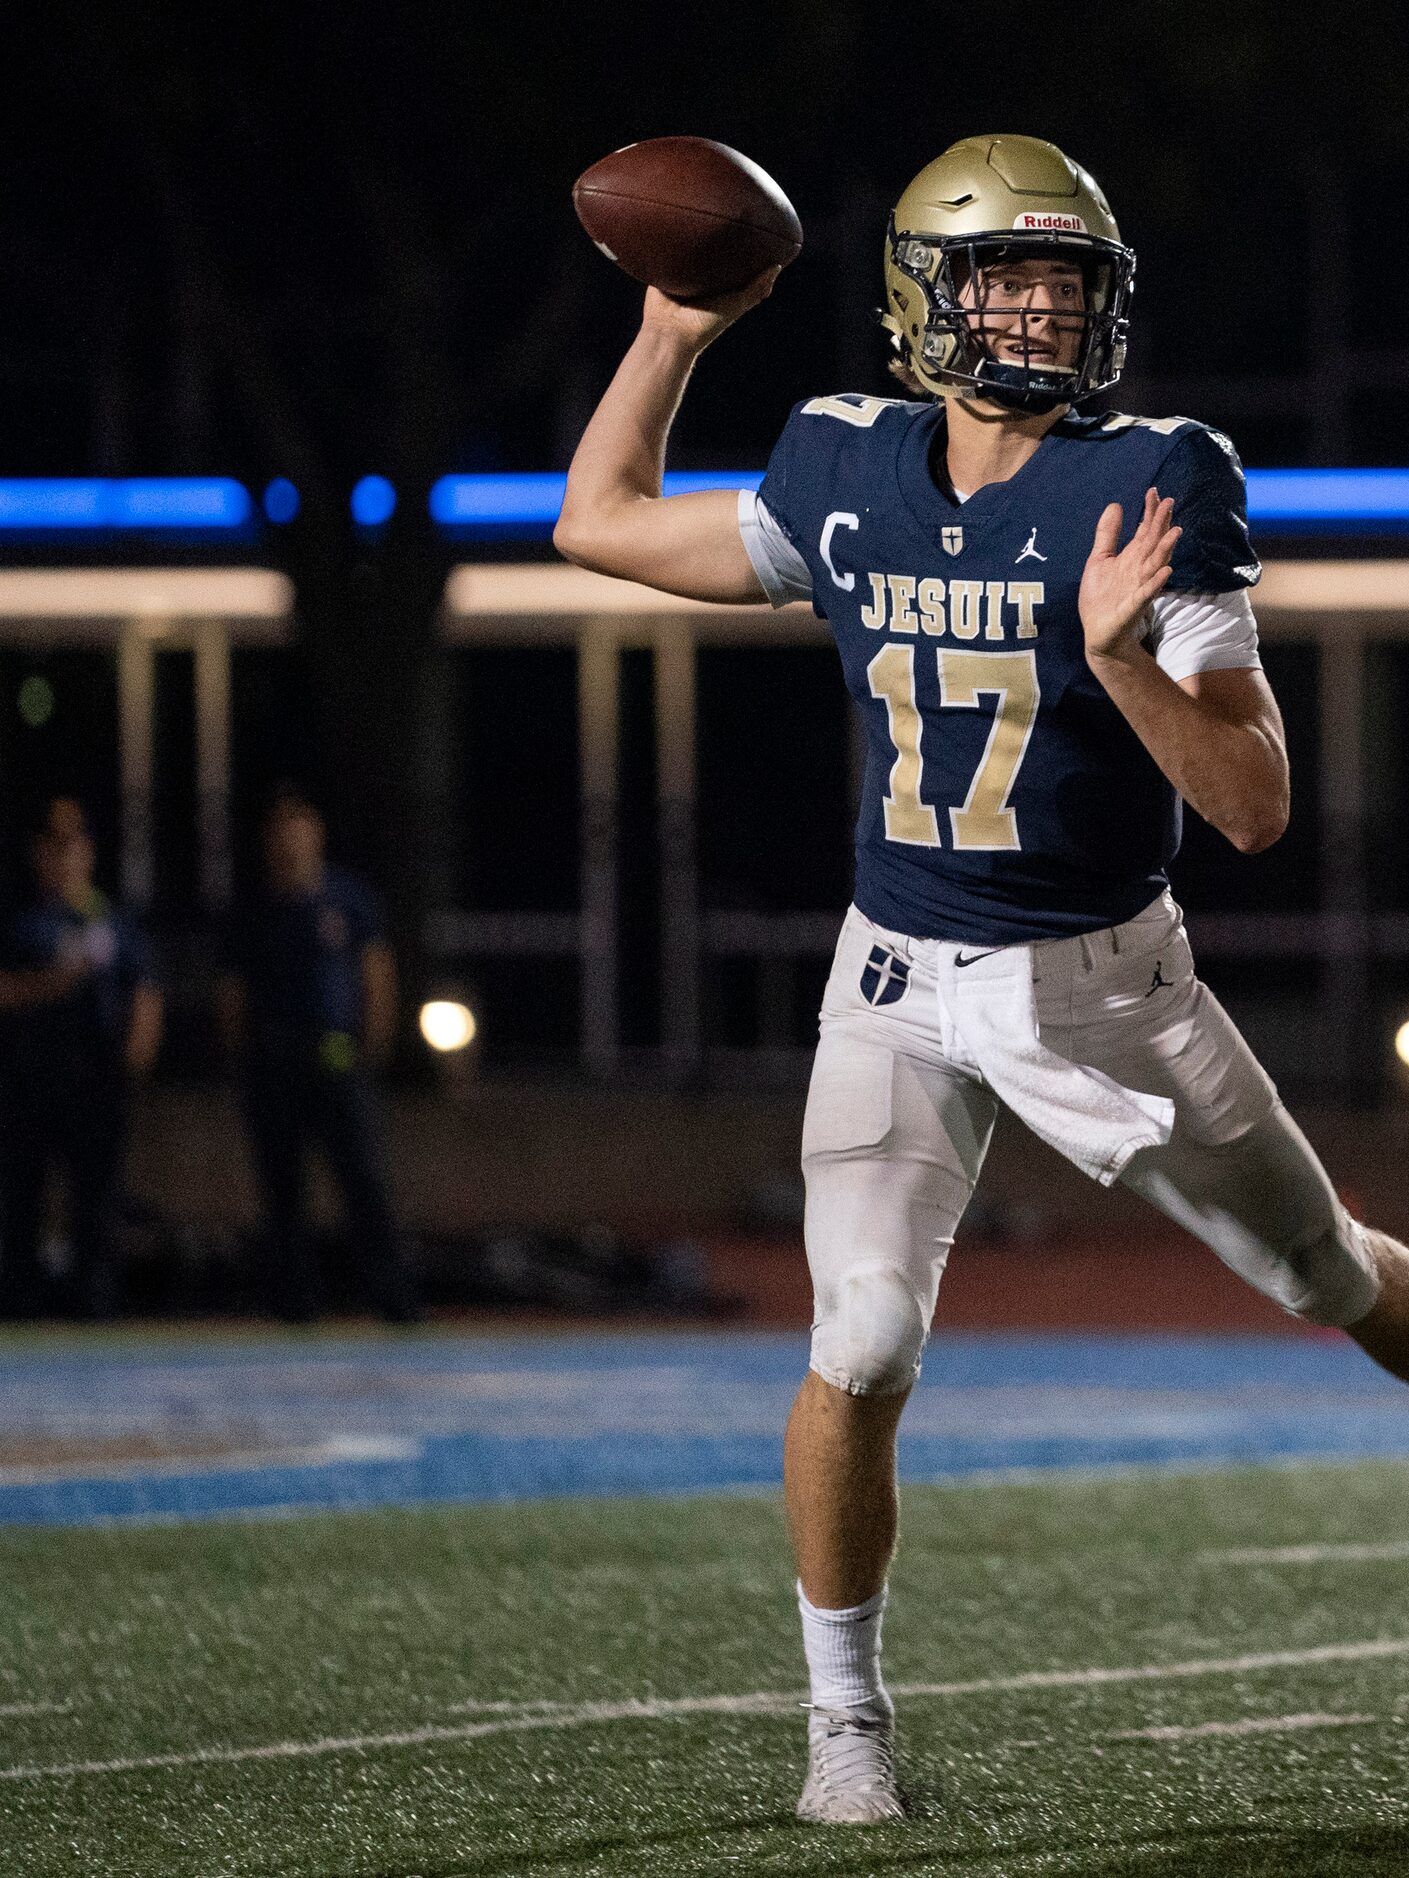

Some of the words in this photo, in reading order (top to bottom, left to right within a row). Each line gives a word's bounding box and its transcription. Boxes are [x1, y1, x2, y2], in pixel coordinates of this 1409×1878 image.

[1024, 215, 1081, 230] Riddell
[818, 511, 859, 592] C
[861, 572, 1045, 641] JESUIT
[867, 643, 1042, 852] 17
